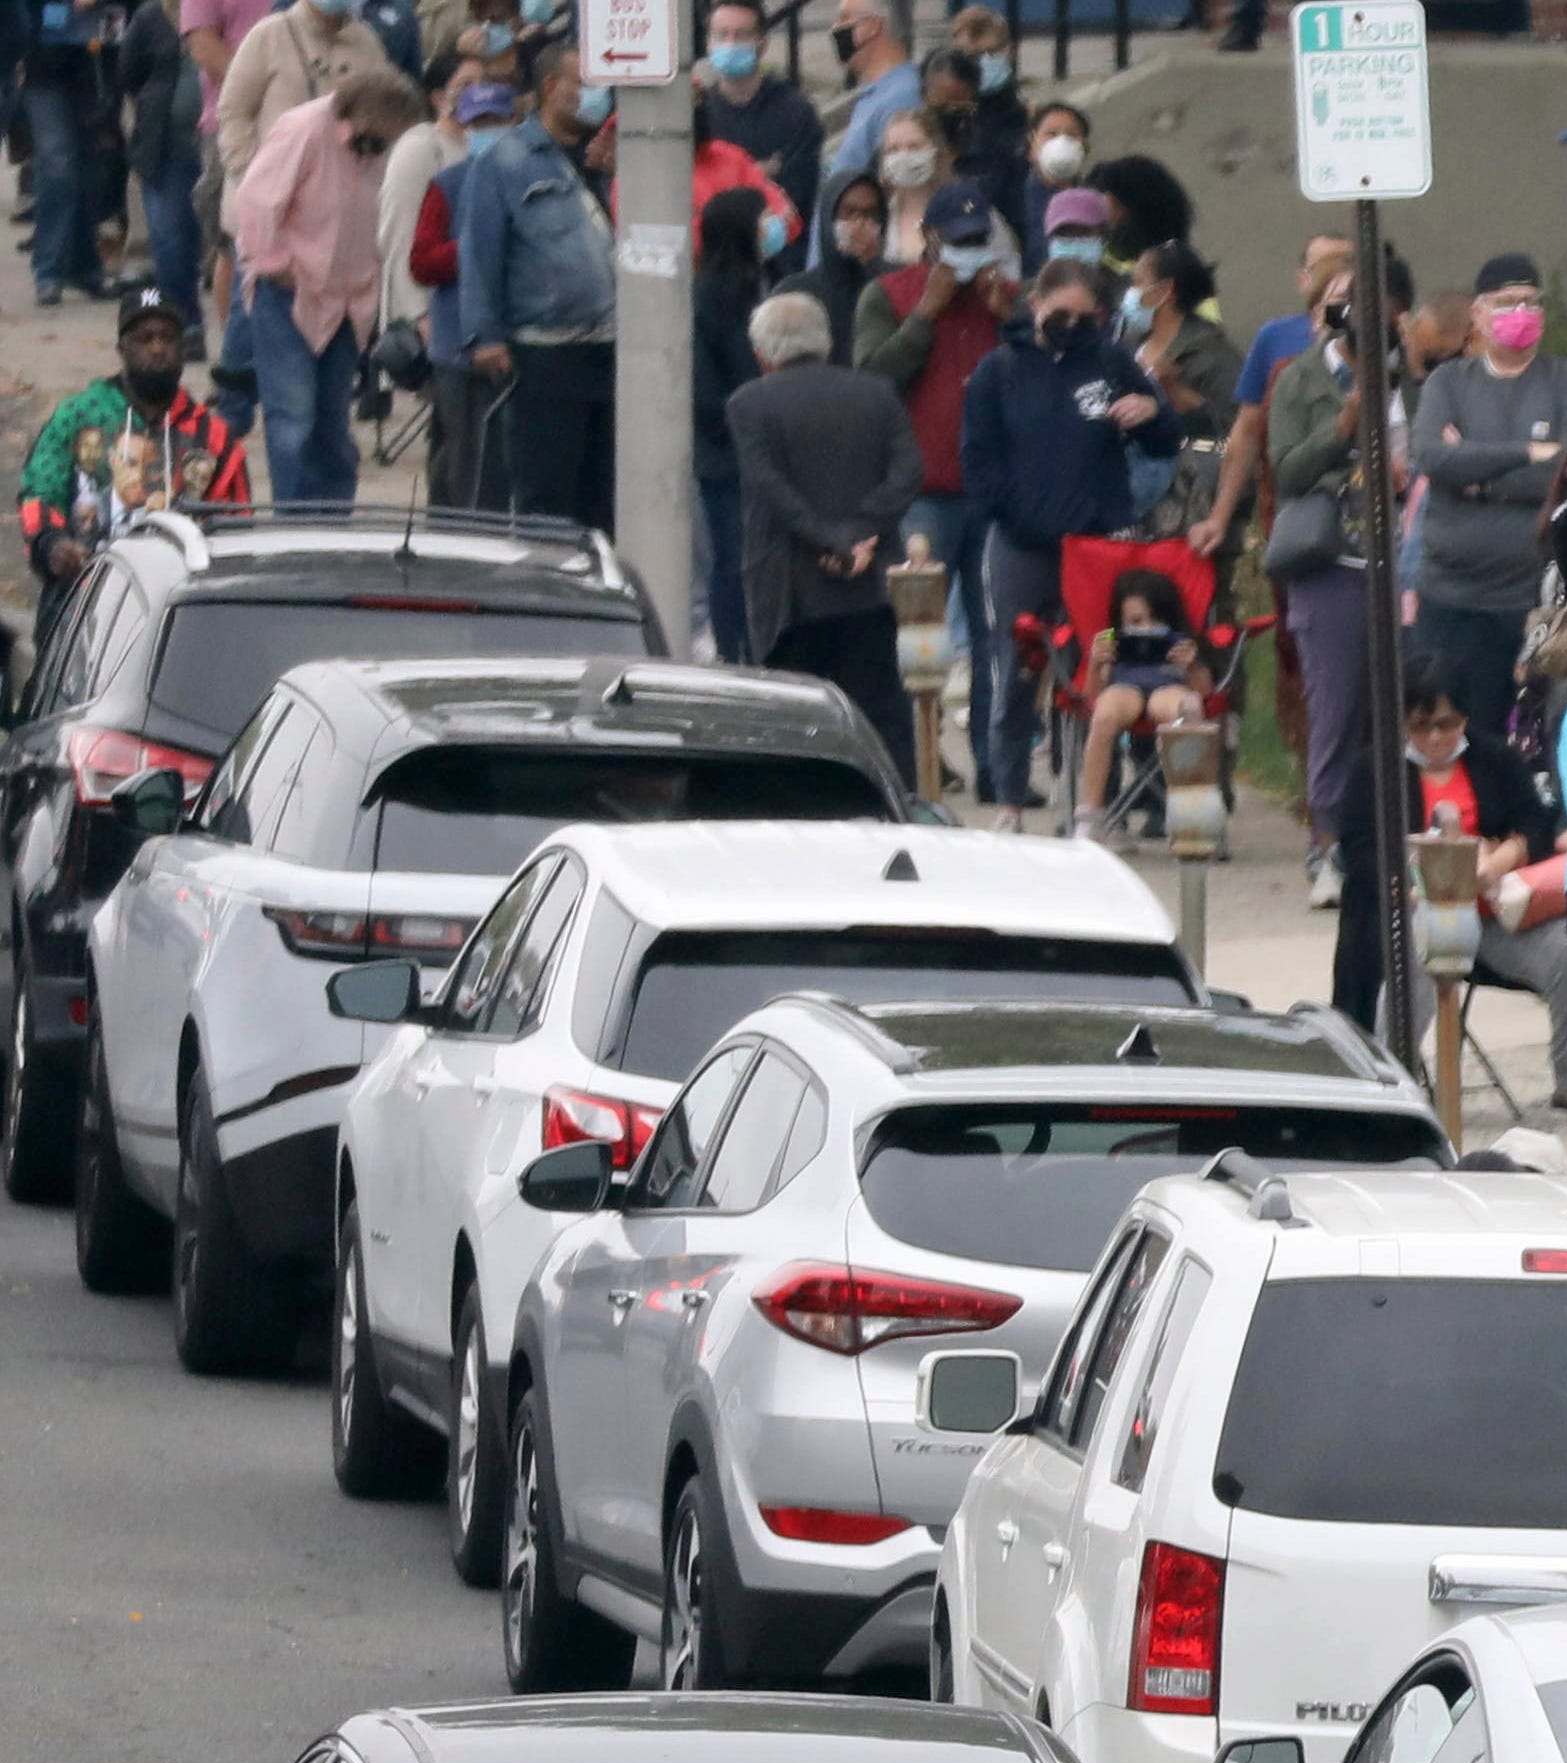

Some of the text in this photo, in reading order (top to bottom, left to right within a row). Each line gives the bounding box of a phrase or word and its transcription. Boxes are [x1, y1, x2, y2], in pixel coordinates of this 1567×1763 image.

[606, 18, 652, 40] STOP
[1314, 11, 1416, 49] 1 HOUR
[1309, 52, 1416, 77] PARKING
[1296, 1700, 1374, 1722] PILO
